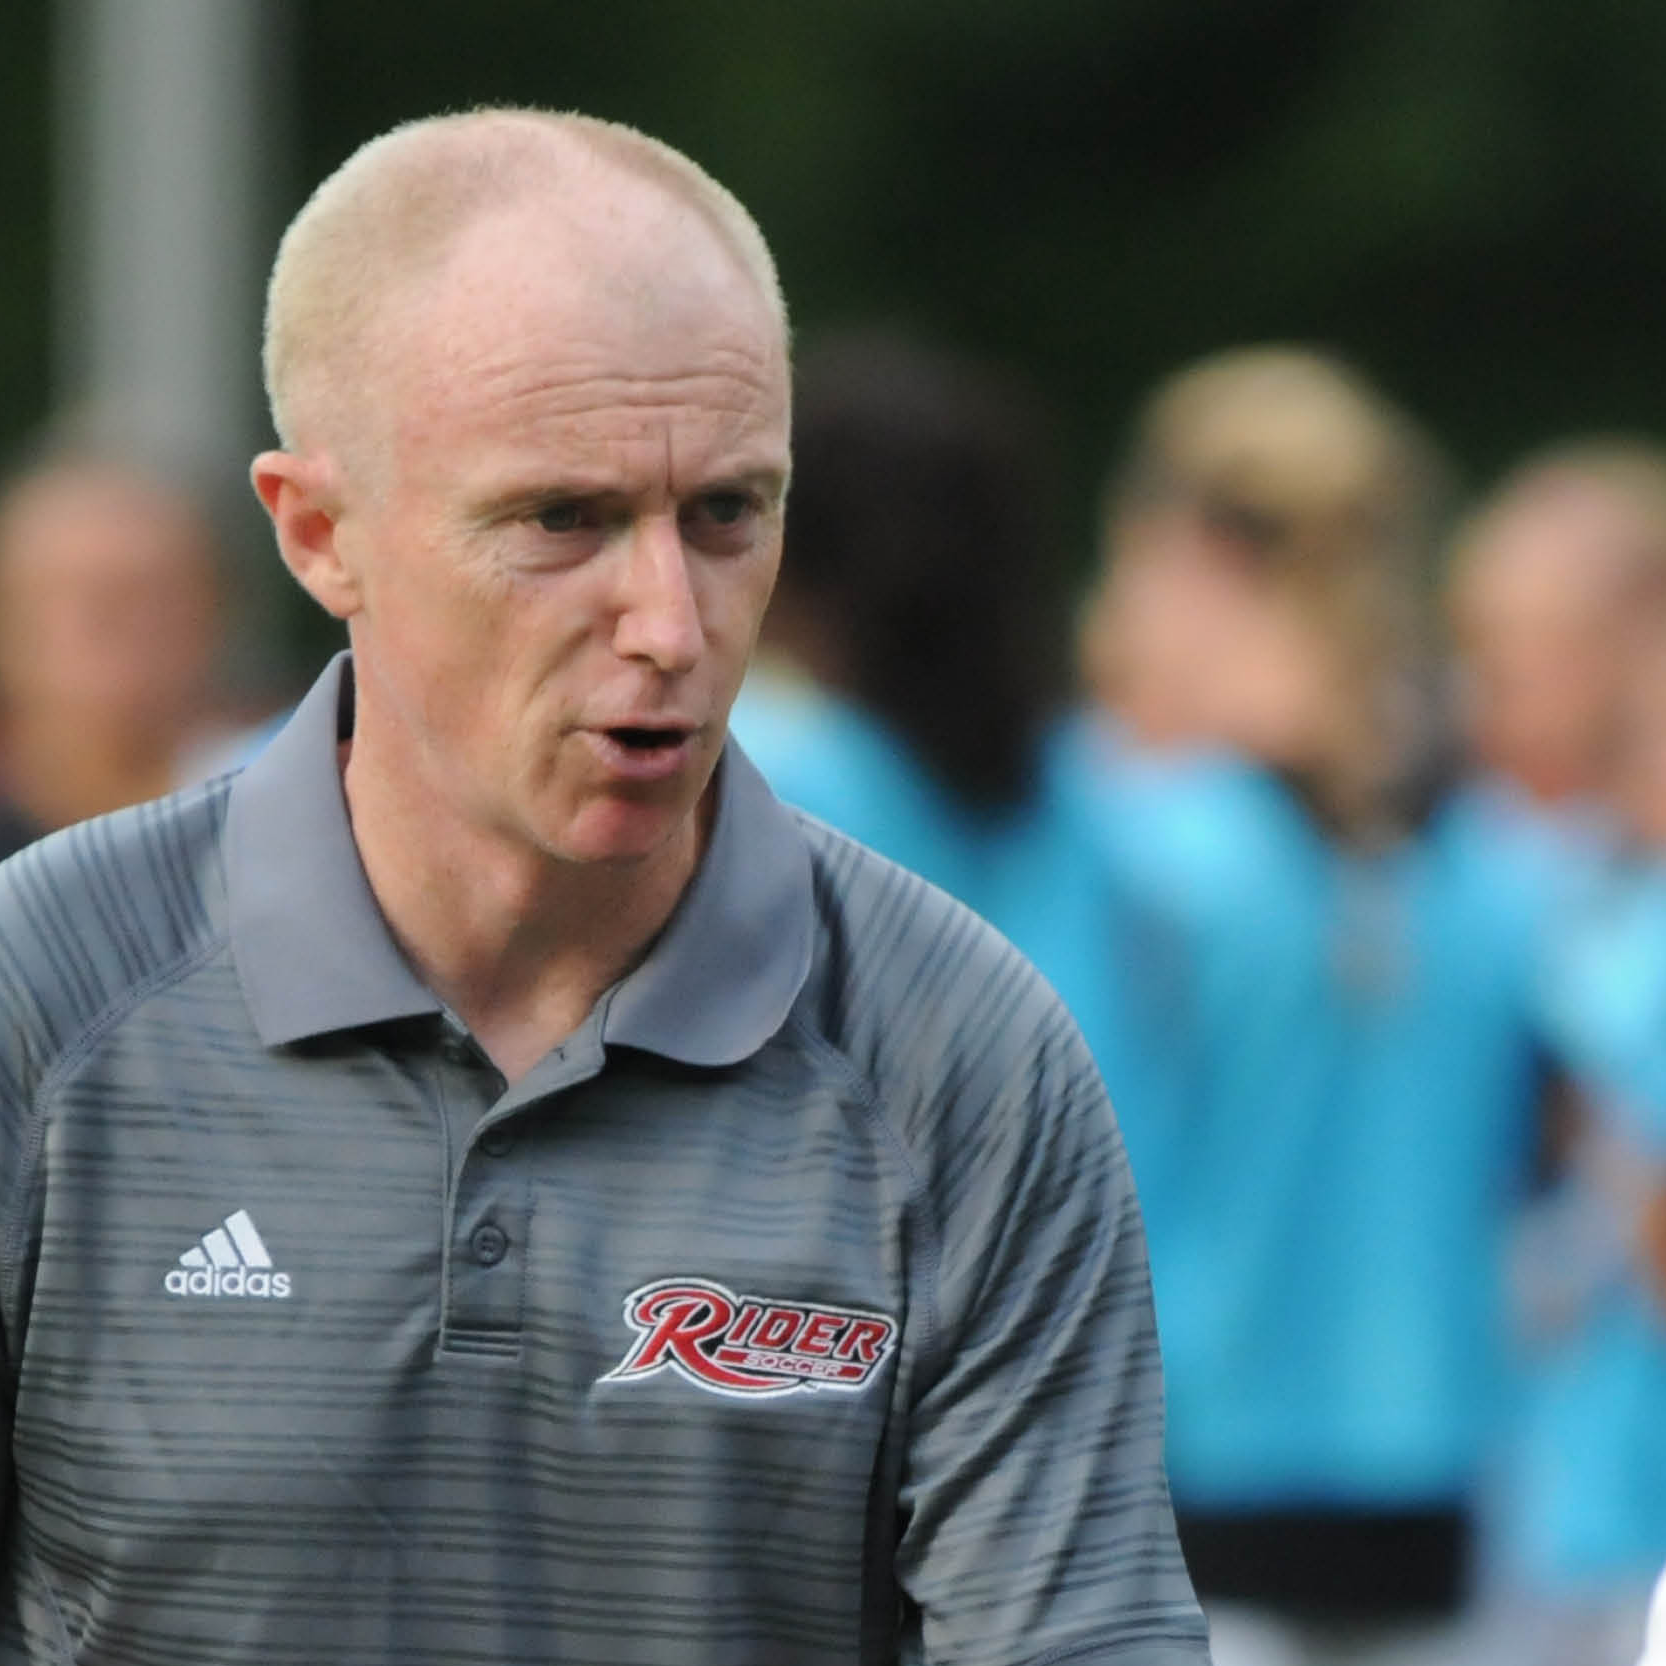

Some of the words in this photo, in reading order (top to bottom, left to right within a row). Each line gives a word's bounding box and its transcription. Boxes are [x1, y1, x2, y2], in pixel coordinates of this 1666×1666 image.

[164, 1263, 293, 1298] adidas
[609, 1280, 895, 1394] RIDER
[742, 1350, 841, 1377] SOCCER
